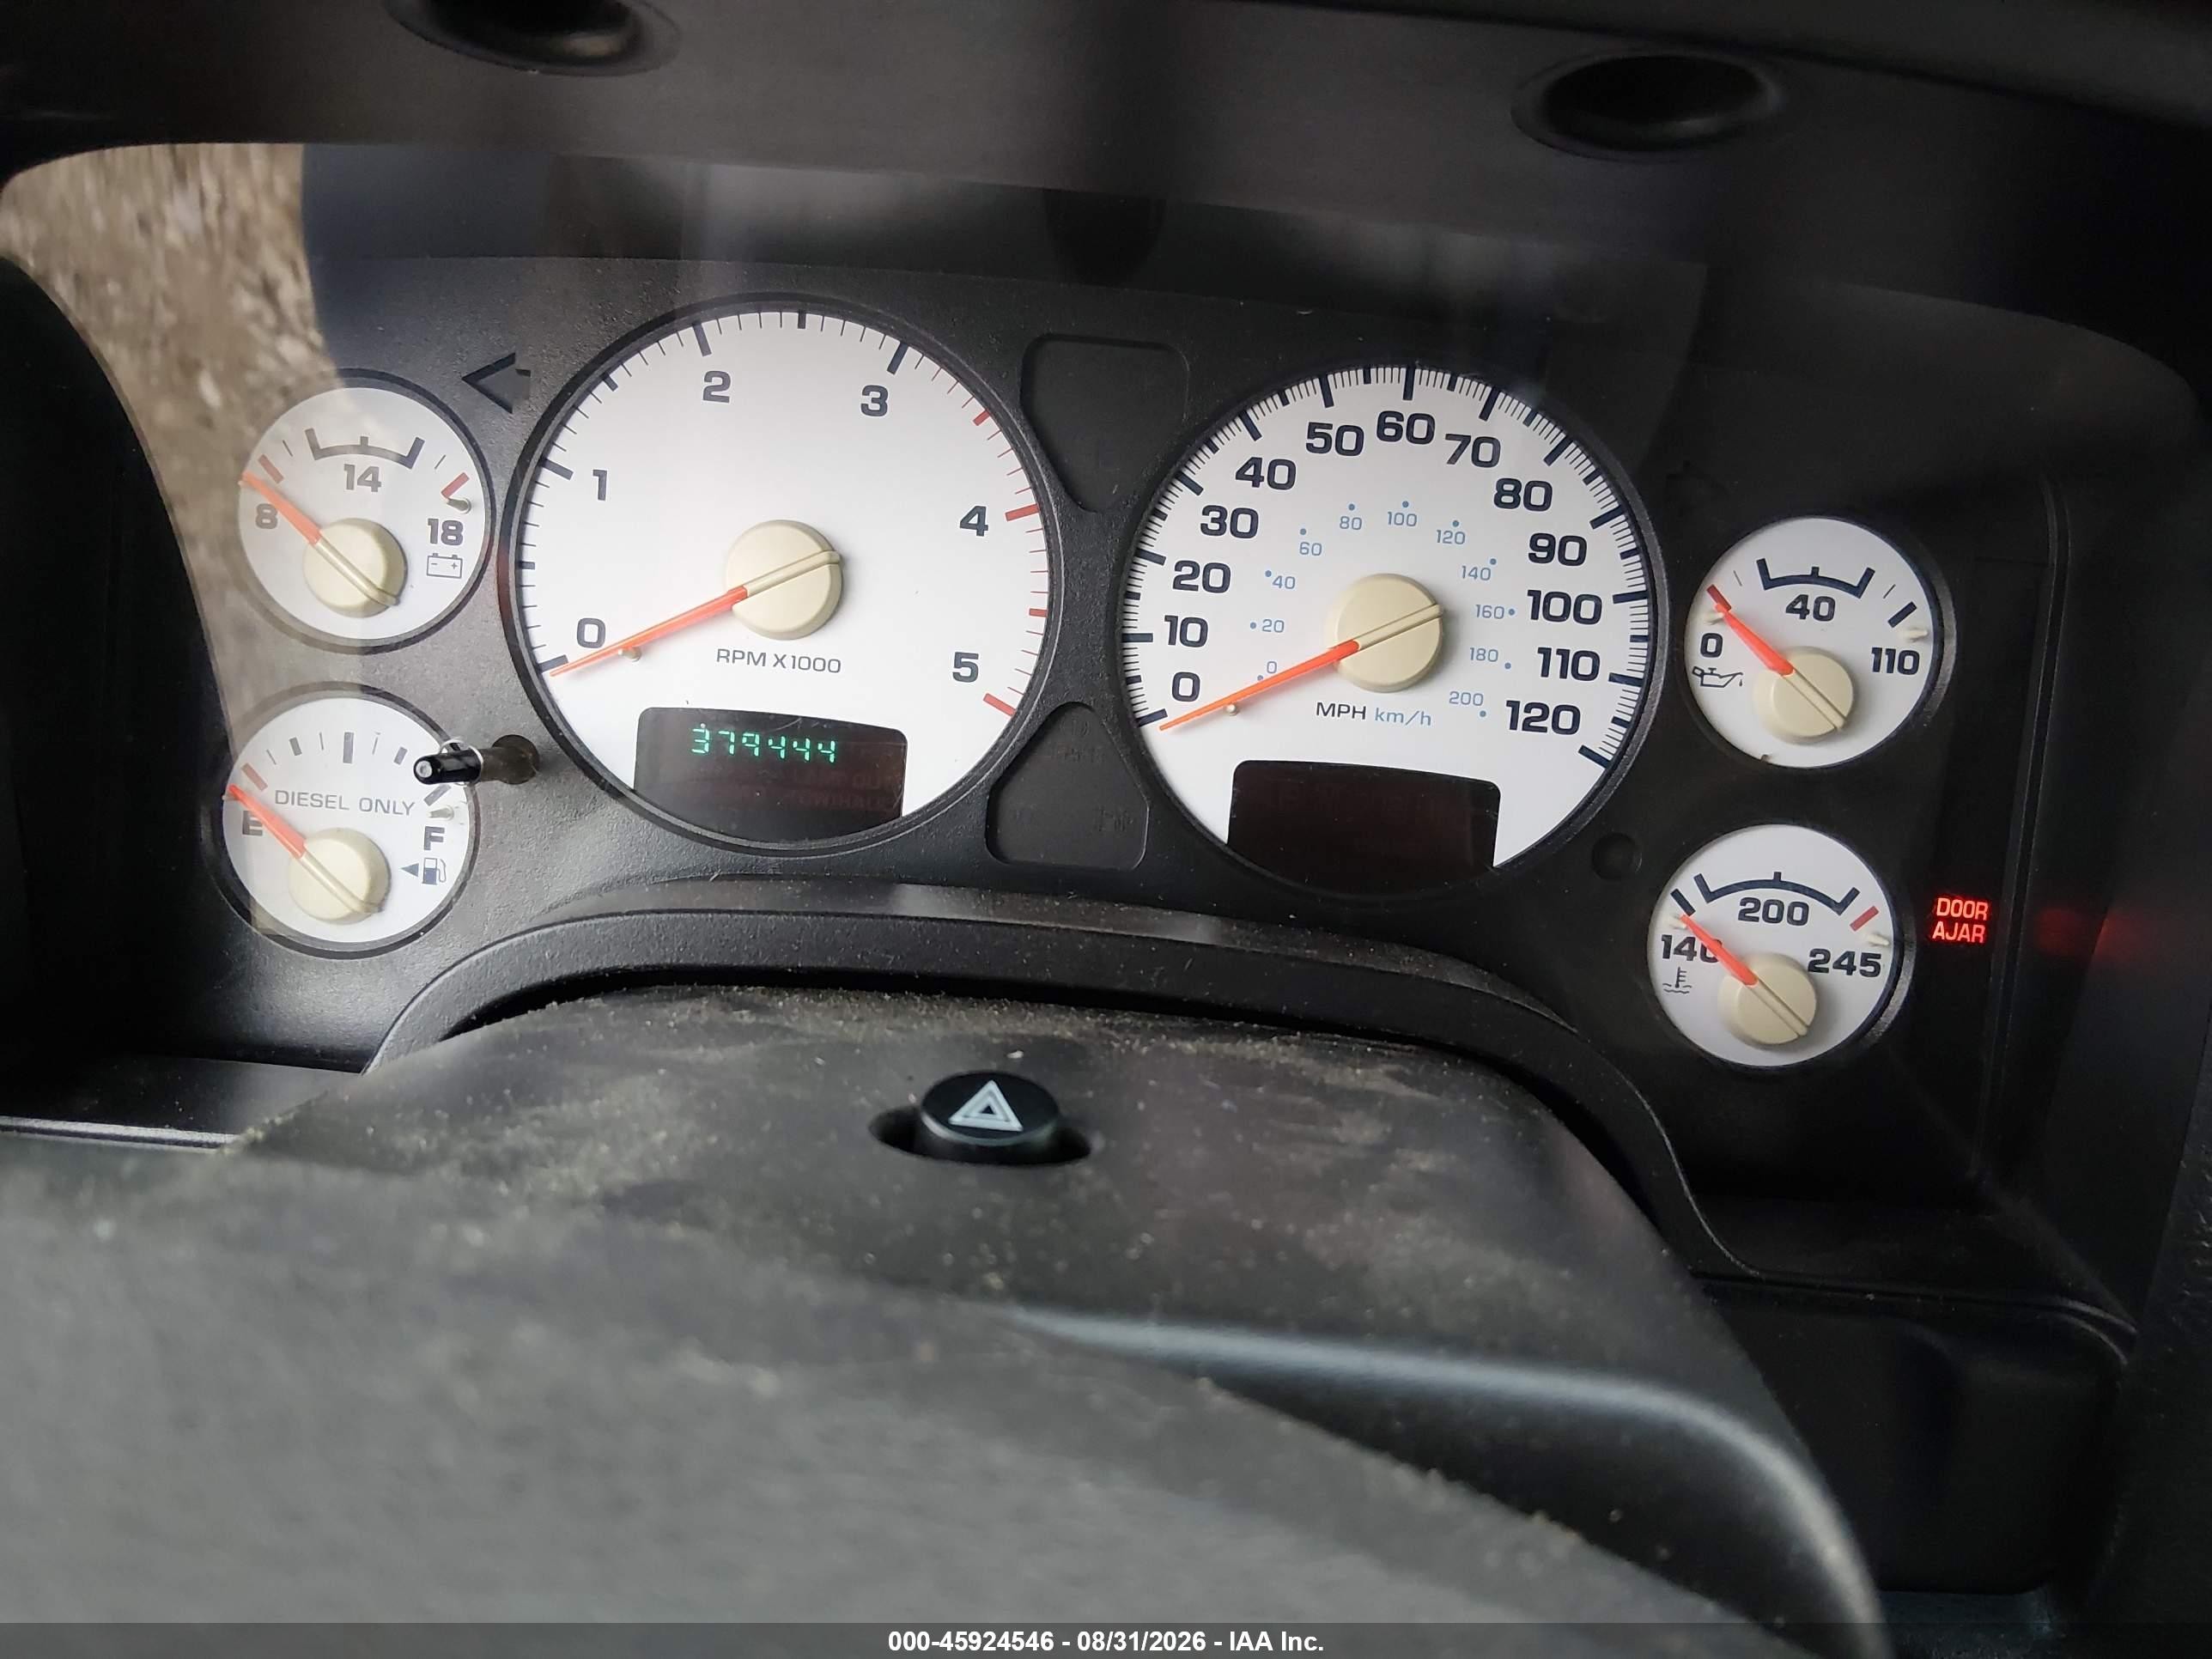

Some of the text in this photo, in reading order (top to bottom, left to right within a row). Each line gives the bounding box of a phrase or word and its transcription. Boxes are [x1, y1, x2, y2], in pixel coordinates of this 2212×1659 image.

[702, 371, 731, 403] 2
[860, 385, 889, 416] 3
[1305, 422, 1364, 456] 50
[1376, 410, 1436, 445] 60
[1444, 433, 1501, 468] 70
[343, 464, 381, 492] 14
[592, 470, 607, 501] 1
[1235, 457, 1297, 490] 40
[1493, 478, 1553, 512] 80
[255, 503, 277, 529] 8
[960, 506, 989, 537] 4
[1200, 505, 1259, 539] 30
[1340, 516, 1363, 531] 80
[1387, 512, 1418, 527] 100
[428, 519, 464, 546] 18
[1436, 530, 1466, 546] 120
[1299, 542, 1322, 557] 60
[1528, 532, 1587, 567] 90
[1173, 560, 1231, 594] 20
[1273, 575, 1296, 590] 40
[1461, 565, 1492, 581] 140
[1475, 605, 1505, 620] 160
[1527, 590, 1602, 624] 100
[1785, 594, 1836, 622] 40
[576, 618, 605, 648] 0
[1164, 615, 1208, 647] 10
[1261, 620, 1285, 635] 20
[1470, 647, 1499, 663] 180
[1700, 633, 1723, 658] 0
[716, 649, 841, 673] RPM X1000
[953, 652, 979, 684] 5
[1267, 661, 1277, 674] 0
[1537, 647, 1601, 682] 110
[1871, 647, 1920, 675] 110
[1172, 672, 1200, 702] 0
[1449, 691, 1484, 707] 200
[1316, 702, 1431, 726] MPH km/h
[1505, 700, 1581, 735] 120
[691, 728, 836, 763] 379444
[275, 790, 415, 816] DIESEL ONLY
[242, 811, 263, 836] E
[423, 826, 445, 850] F
[1737, 896, 1810, 927] 200
[1936, 897, 1989, 921] DOOR
[1932, 921, 1985, 943] AJAR
[1808, 948, 1881, 978] 245
